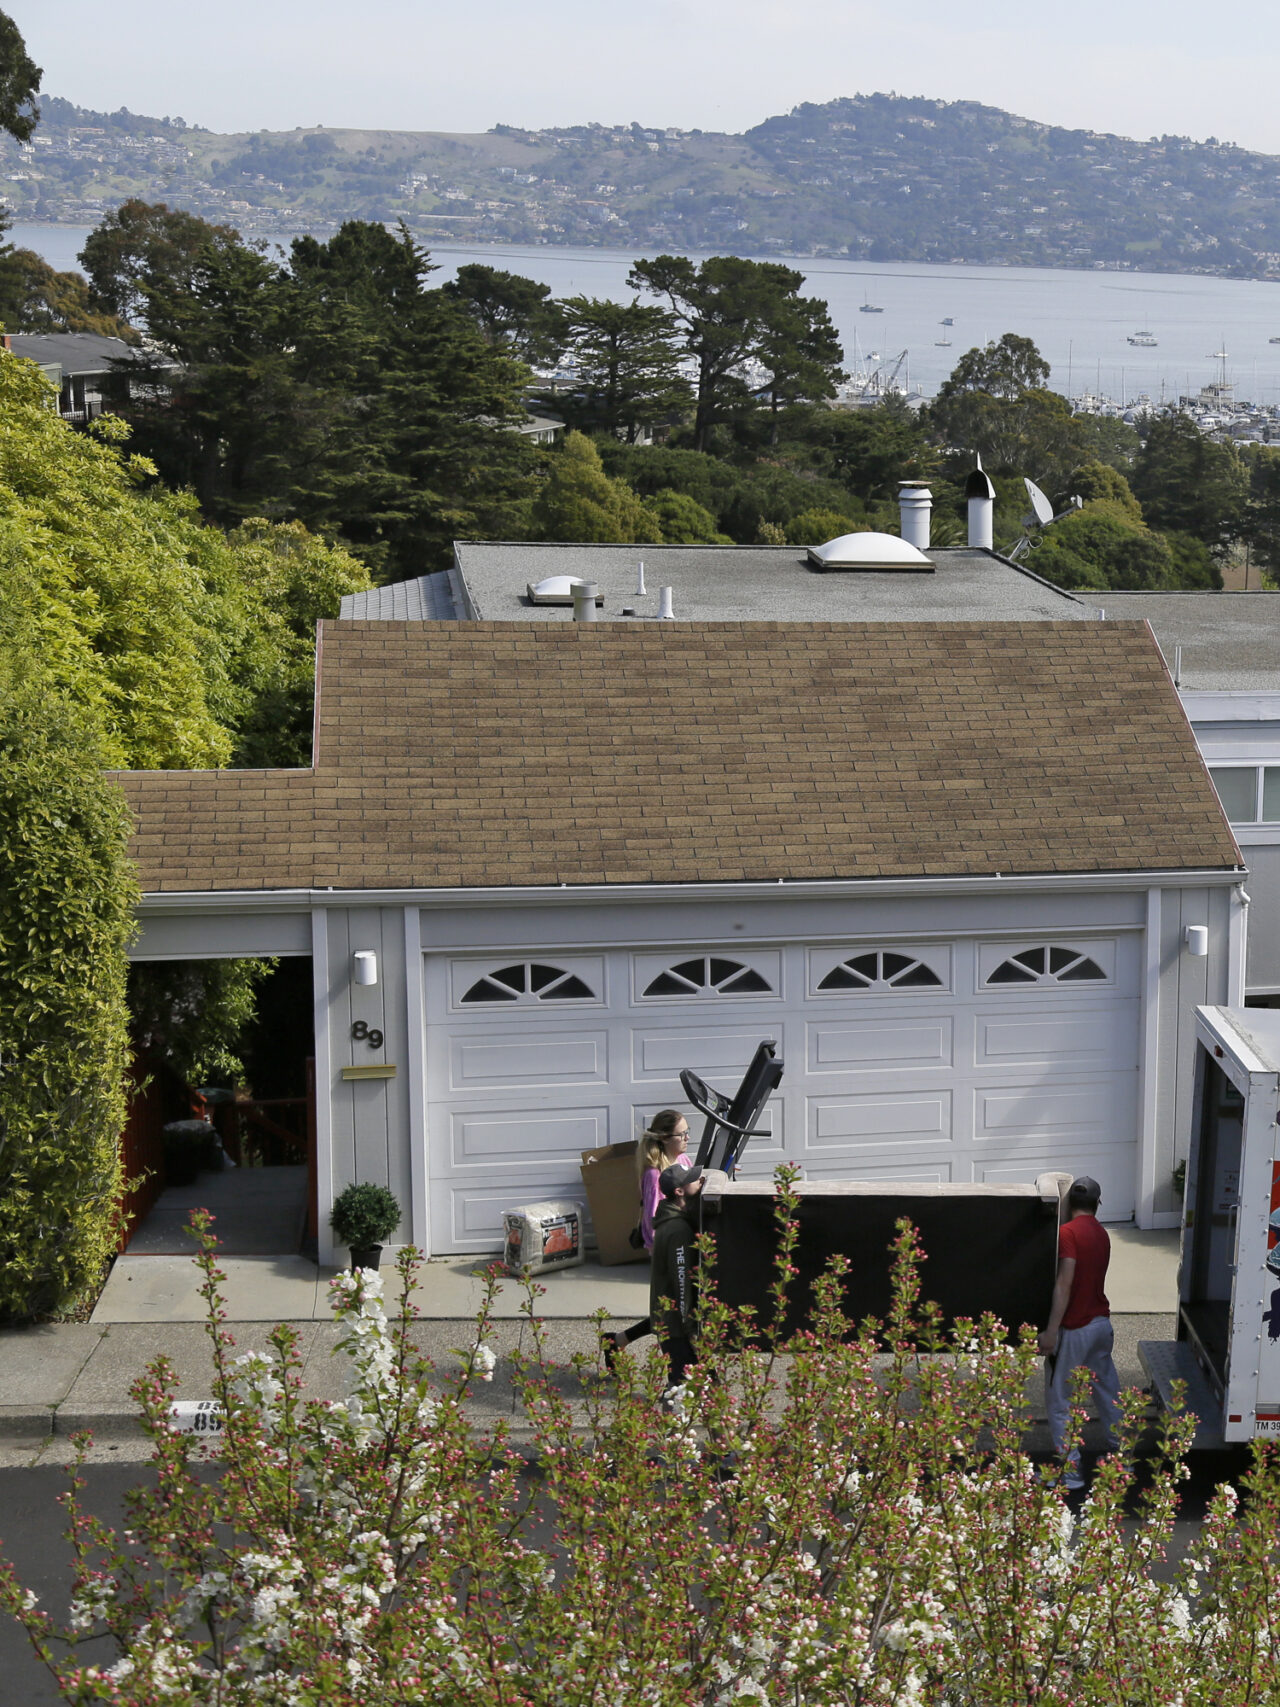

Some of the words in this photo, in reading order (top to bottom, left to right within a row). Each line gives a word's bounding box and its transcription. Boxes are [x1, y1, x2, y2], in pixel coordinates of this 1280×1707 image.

[352, 1020, 383, 1049] 89
[676, 1246, 684, 1264] THE
[194, 1413, 221, 1431] 89
[1256, 1421, 1269, 1430] TM
